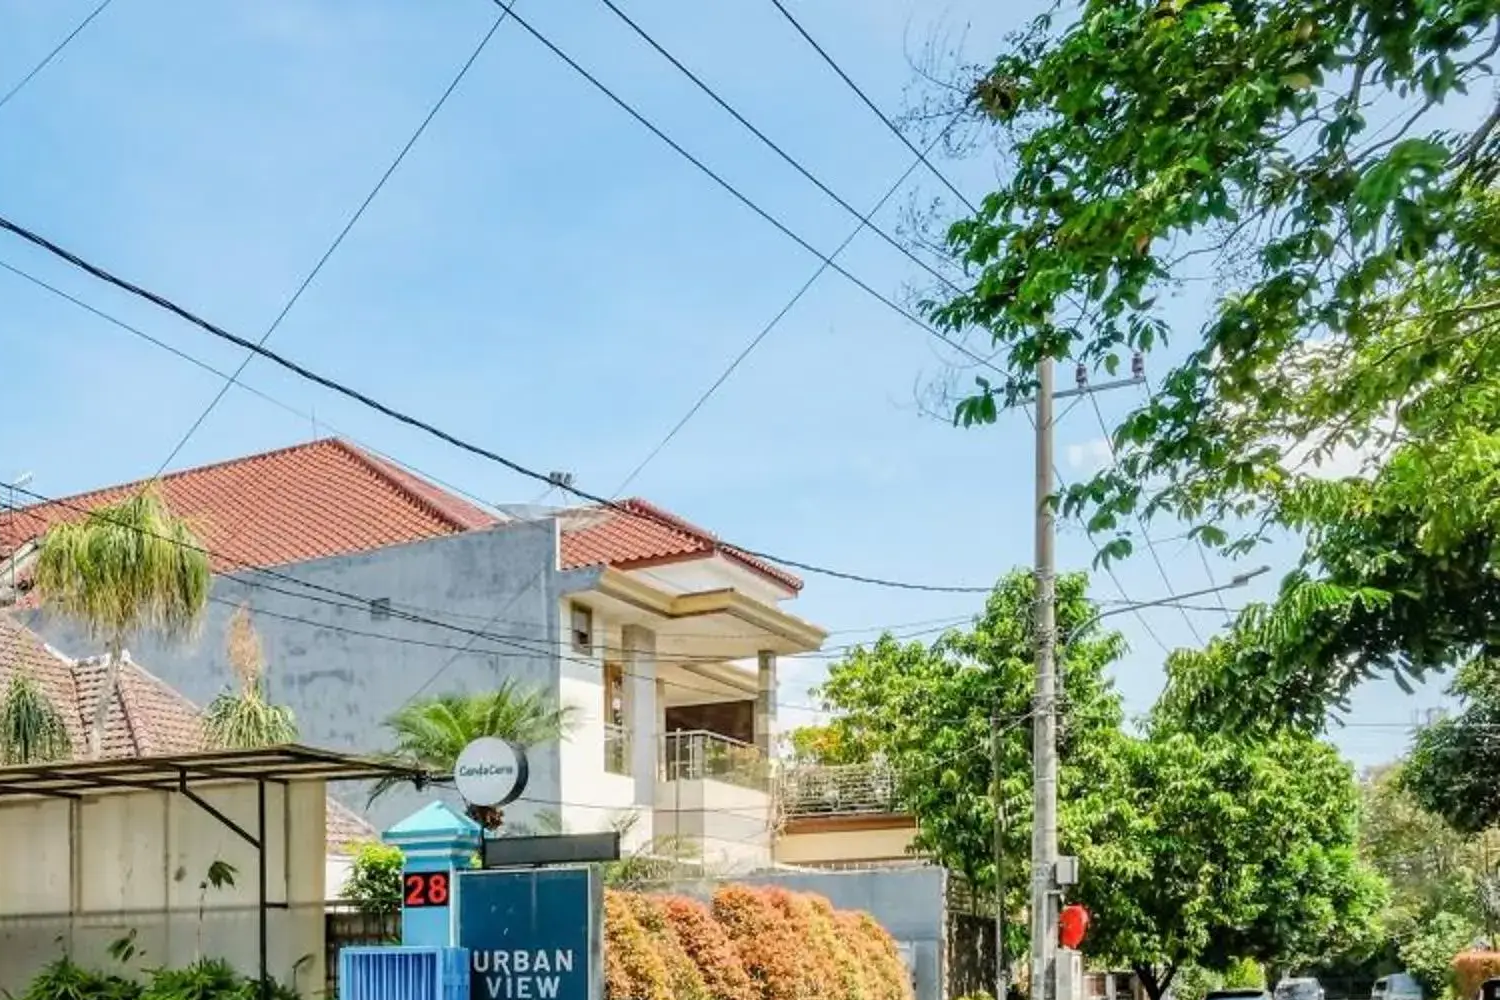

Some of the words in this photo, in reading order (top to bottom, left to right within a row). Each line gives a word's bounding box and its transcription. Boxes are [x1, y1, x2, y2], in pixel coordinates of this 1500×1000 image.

[406, 874, 447, 905] 28
[473, 949, 573, 974] URBAN
[485, 975, 561, 999] VIEW
